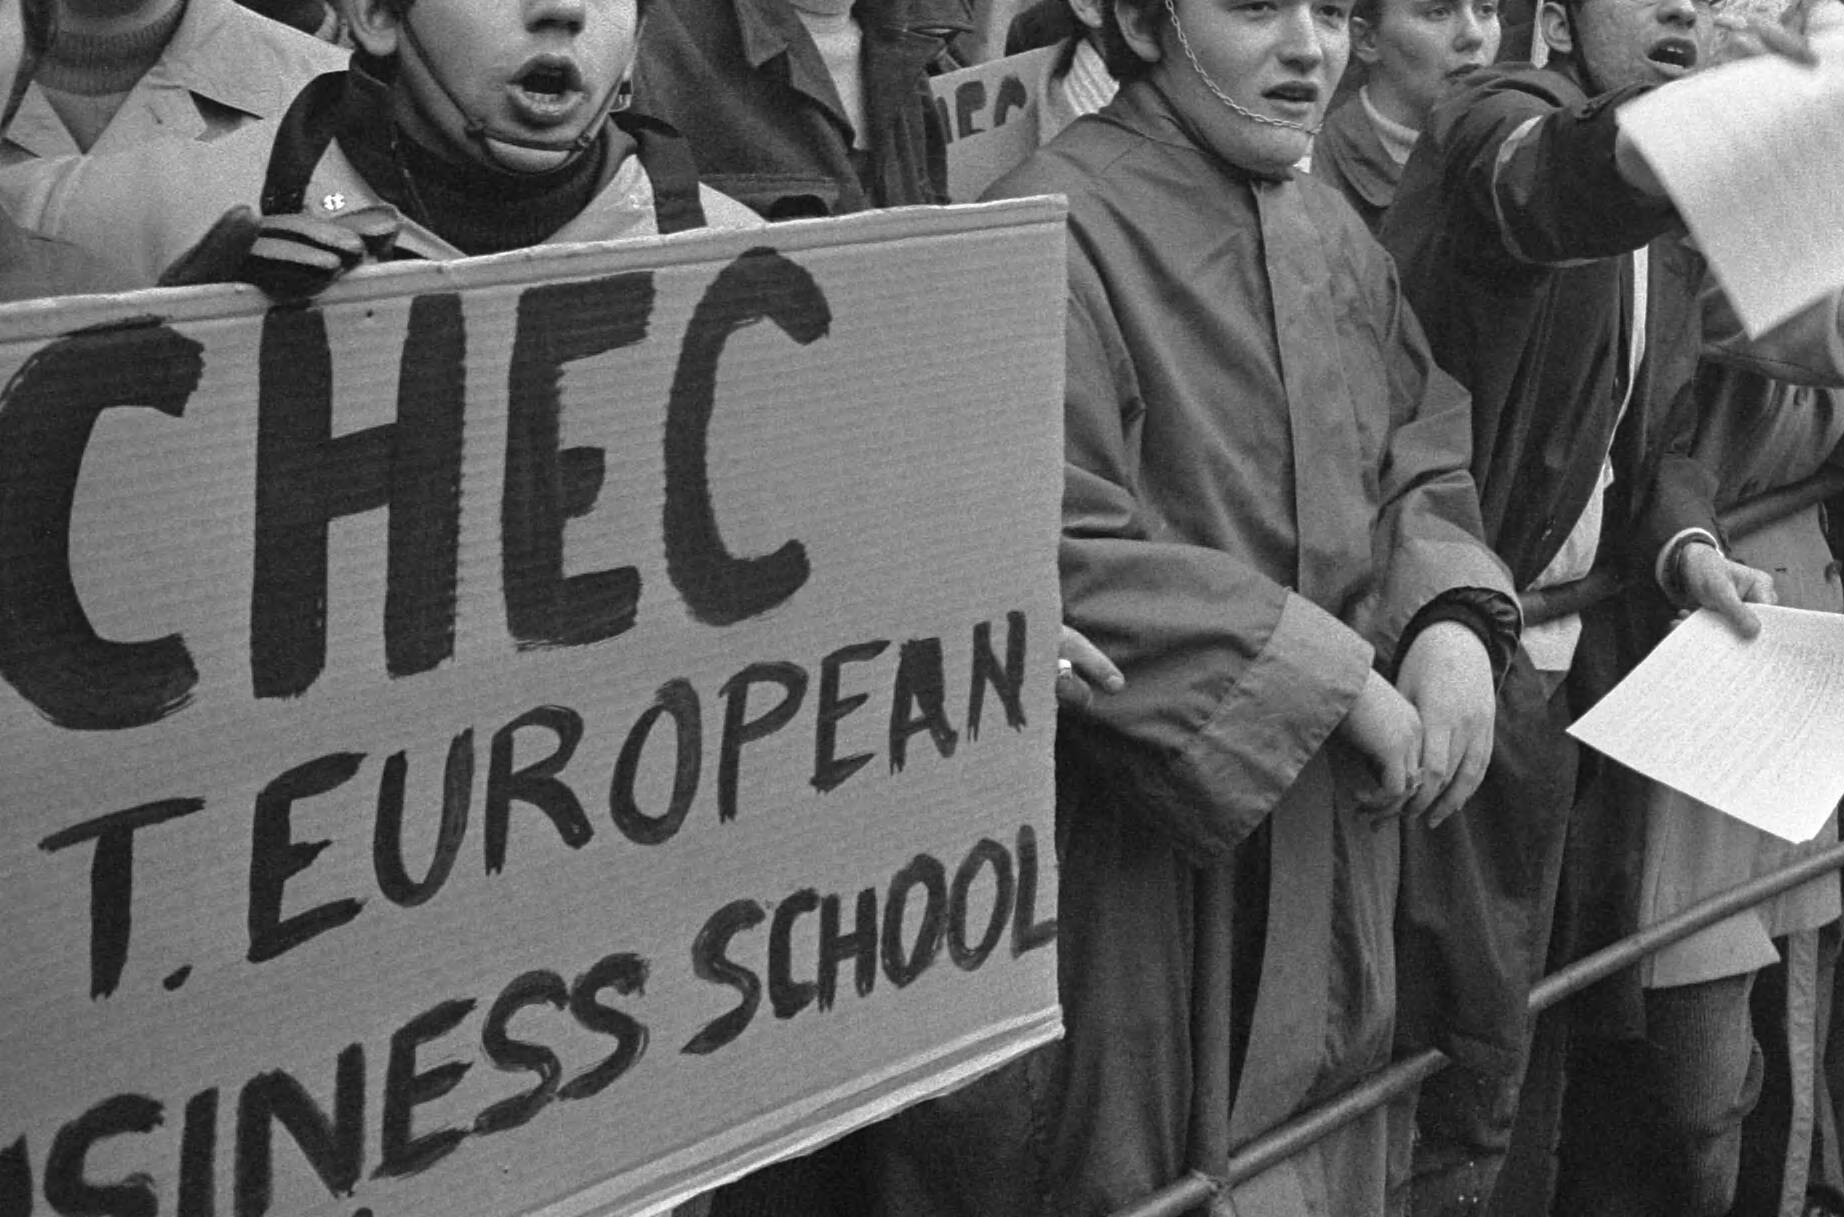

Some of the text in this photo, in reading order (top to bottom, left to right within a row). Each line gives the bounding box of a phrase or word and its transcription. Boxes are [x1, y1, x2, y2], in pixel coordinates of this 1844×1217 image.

[0, 246, 833, 731] CHEC
[246, 610, 1028, 963] EUROPEAN
[681, 825, 1059, 1056] SCHOOL
